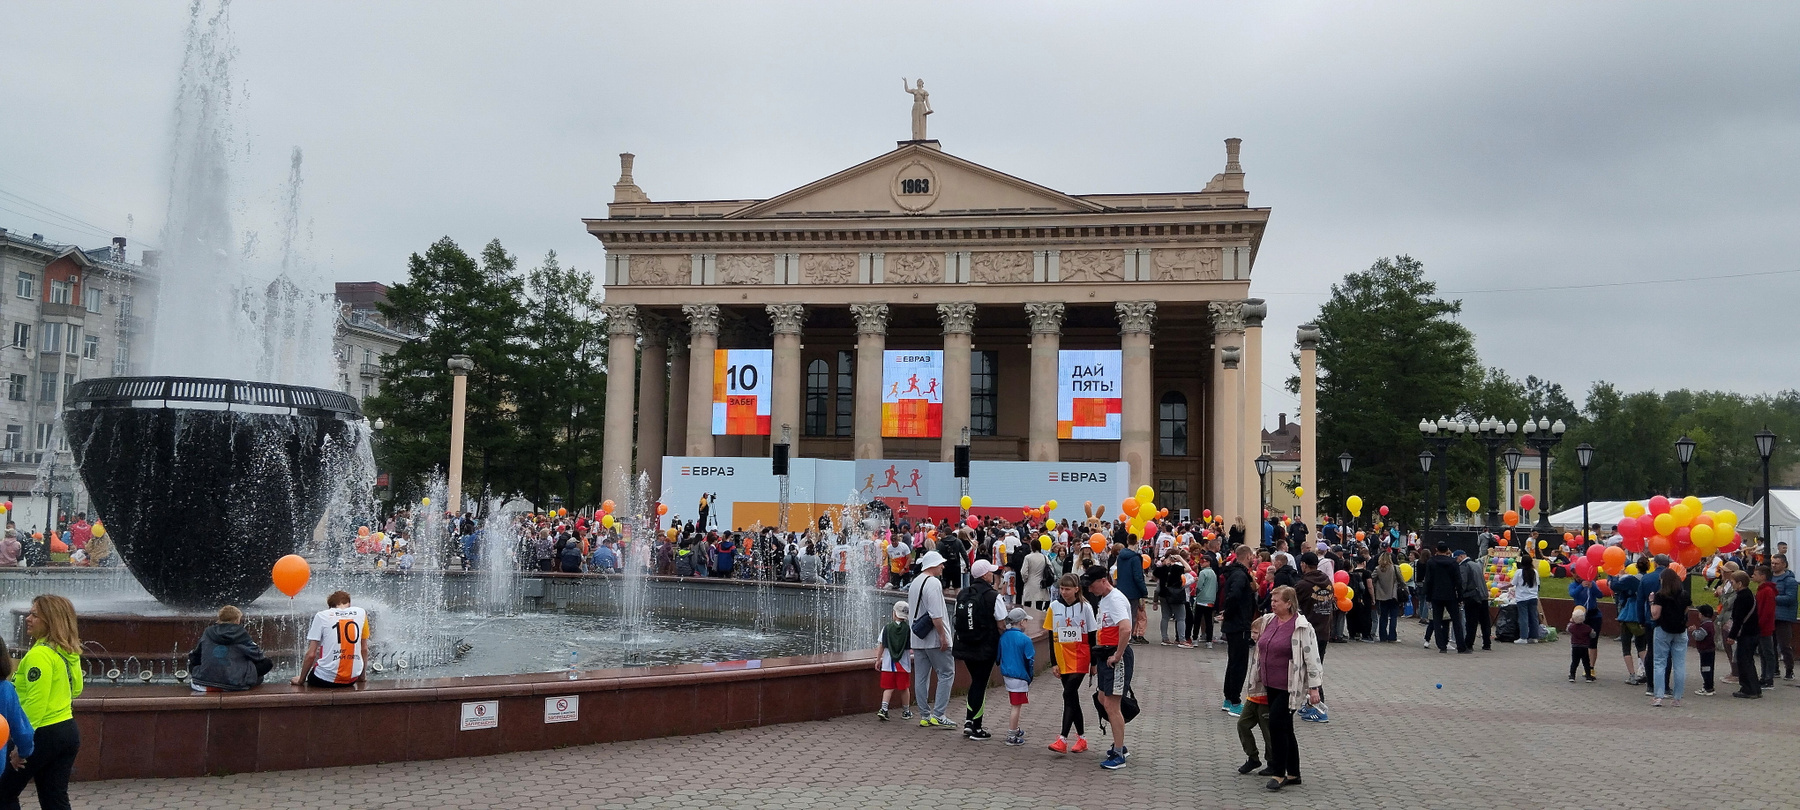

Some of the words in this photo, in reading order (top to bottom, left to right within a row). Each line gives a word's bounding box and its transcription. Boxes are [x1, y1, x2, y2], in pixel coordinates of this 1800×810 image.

[901, 178, 929, 194] 1963
[1072, 363, 1104, 378] ДАЙ
[727, 364, 758, 391] 10
[1072, 380, 1113, 391] ПЯТЬ!
[729, 398, 755, 406] ЗАБЕГ
[693, 466, 735, 476] ЕВРАЗ
[1061, 472, 1107, 482] ЕВРАЗ
[331, 621, 360, 644] 10
[1063, 630, 1077, 638] 799
